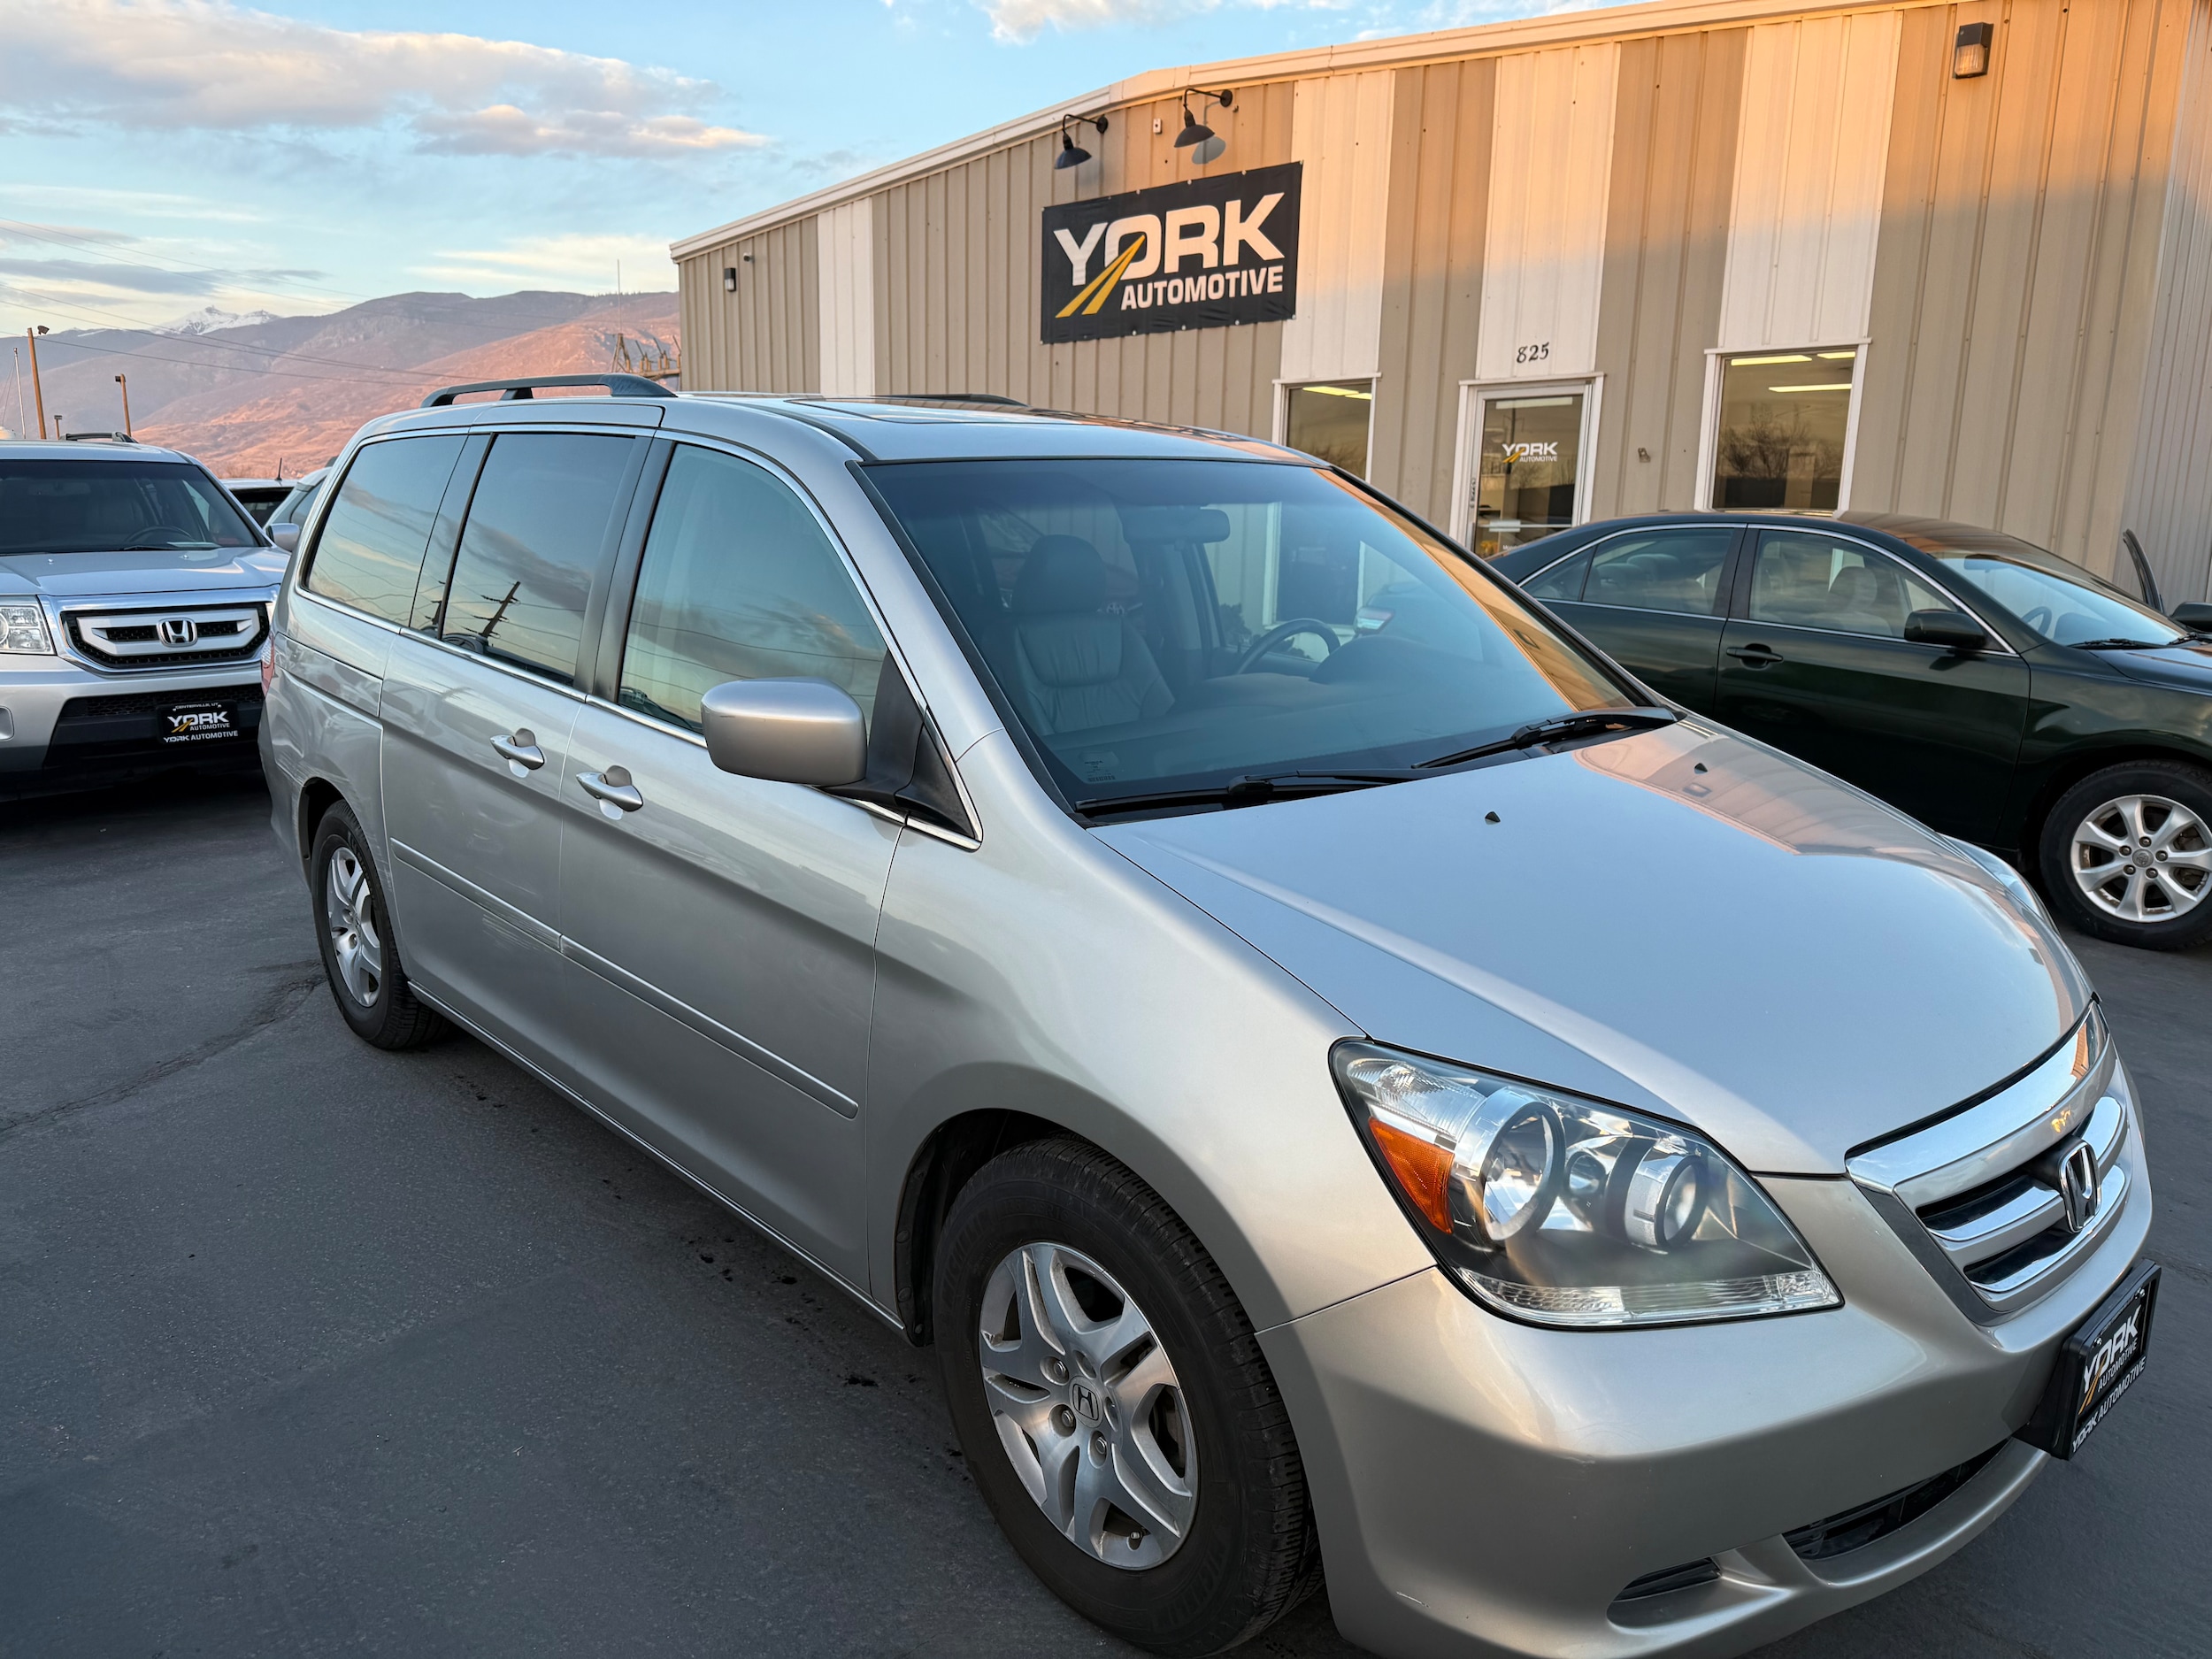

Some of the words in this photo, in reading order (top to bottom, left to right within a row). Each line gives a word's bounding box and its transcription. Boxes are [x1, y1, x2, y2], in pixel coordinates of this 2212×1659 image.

[1053, 192, 1286, 287] YORK
[1120, 265, 1284, 311] AUTOMOTIVE
[1516, 342, 1549, 364] 825
[1502, 442, 1558, 457] YORK
[167, 711, 229, 726] YORK
[191, 730, 238, 741] AUTOMOTIVE
[2083, 1304, 2142, 1394] YORK
[2097, 1337, 2139, 1393] AUTOMOTIVE
[2072, 1411, 2099, 1454] YORK
[2097, 1356, 2147, 1423] AUTOMOTIVE
